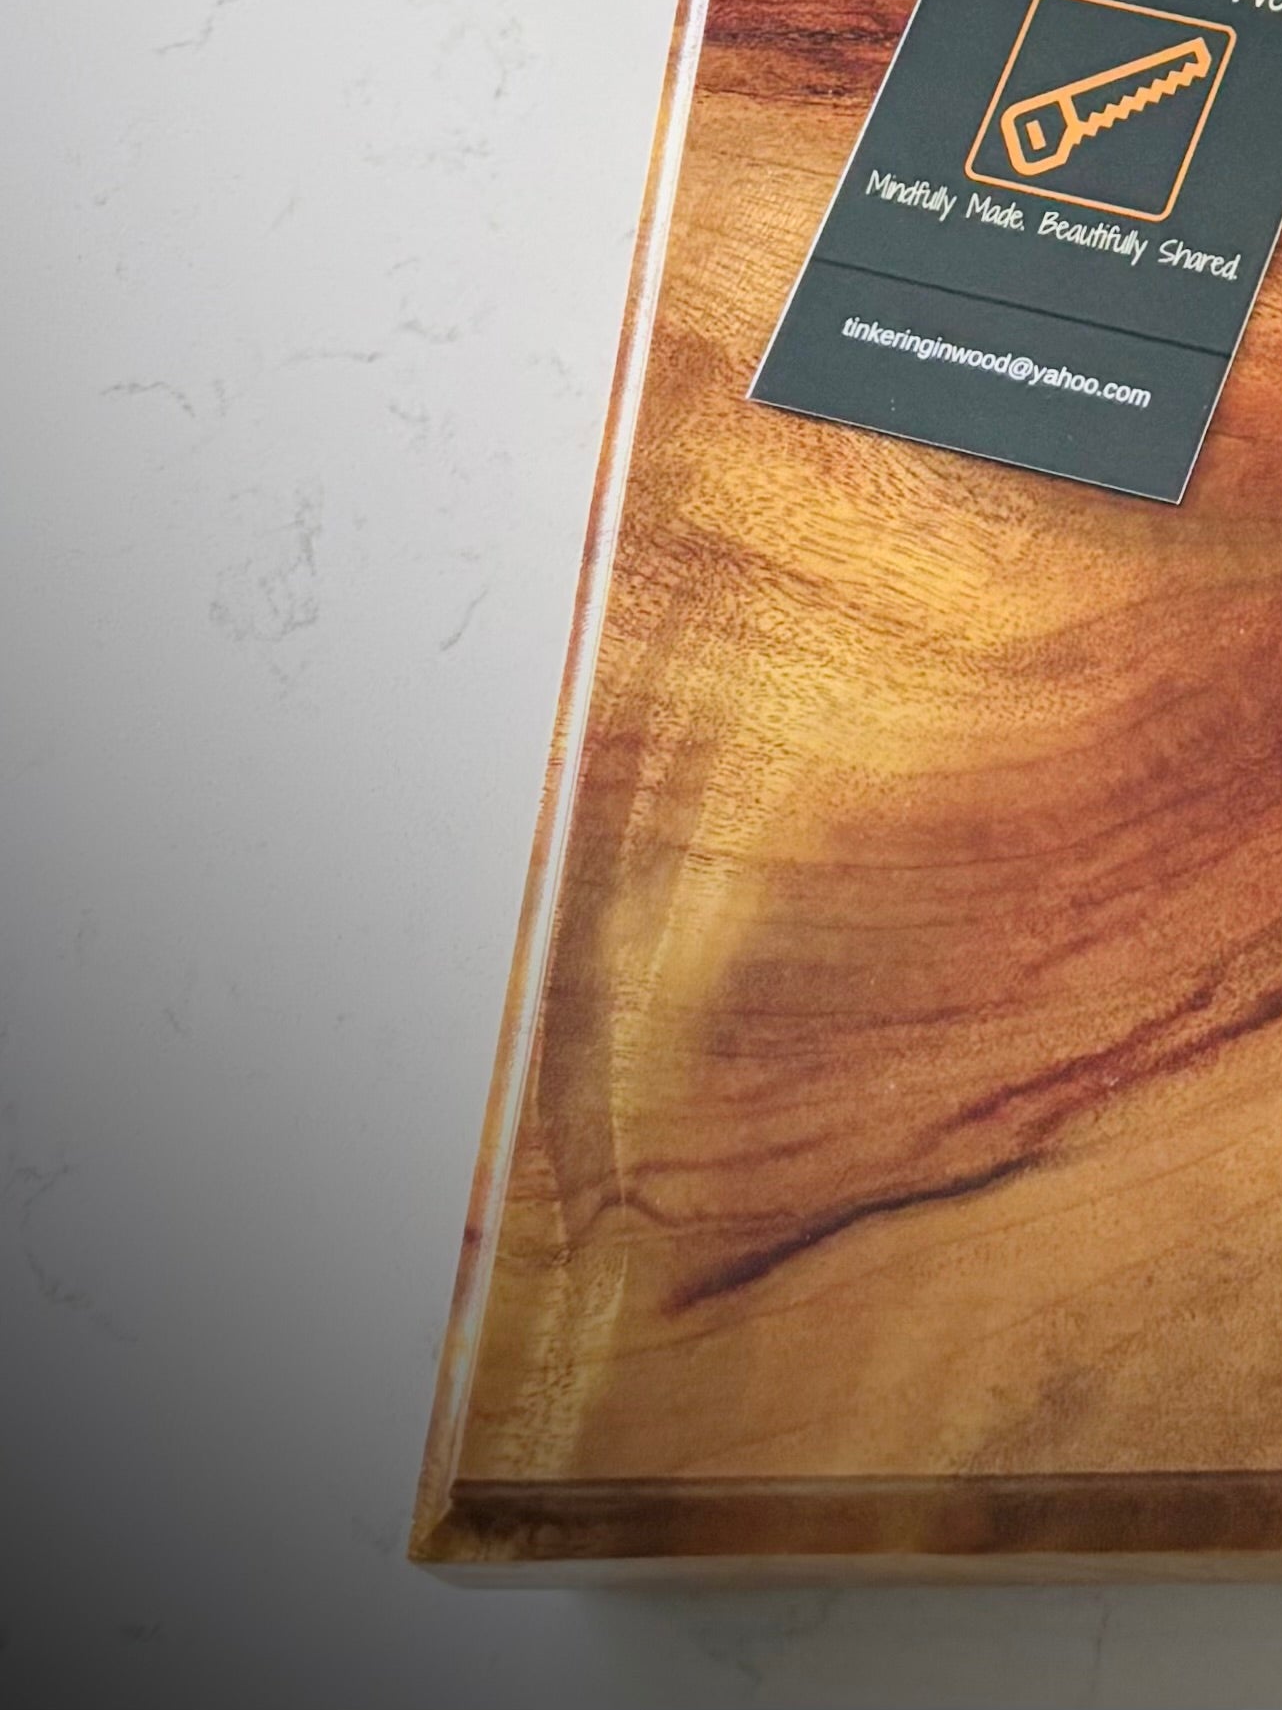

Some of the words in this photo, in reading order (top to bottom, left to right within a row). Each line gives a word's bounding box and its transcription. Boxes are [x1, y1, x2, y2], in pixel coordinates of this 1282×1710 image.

[864, 168, 958, 222] Mindfully
[964, 192, 1027, 231] Made.
[1036, 210, 1149, 267] Beautifully
[1157, 238, 1240, 281] Shared.
[840, 315, 1153, 409] tinkeringinwood@yahoo.com
